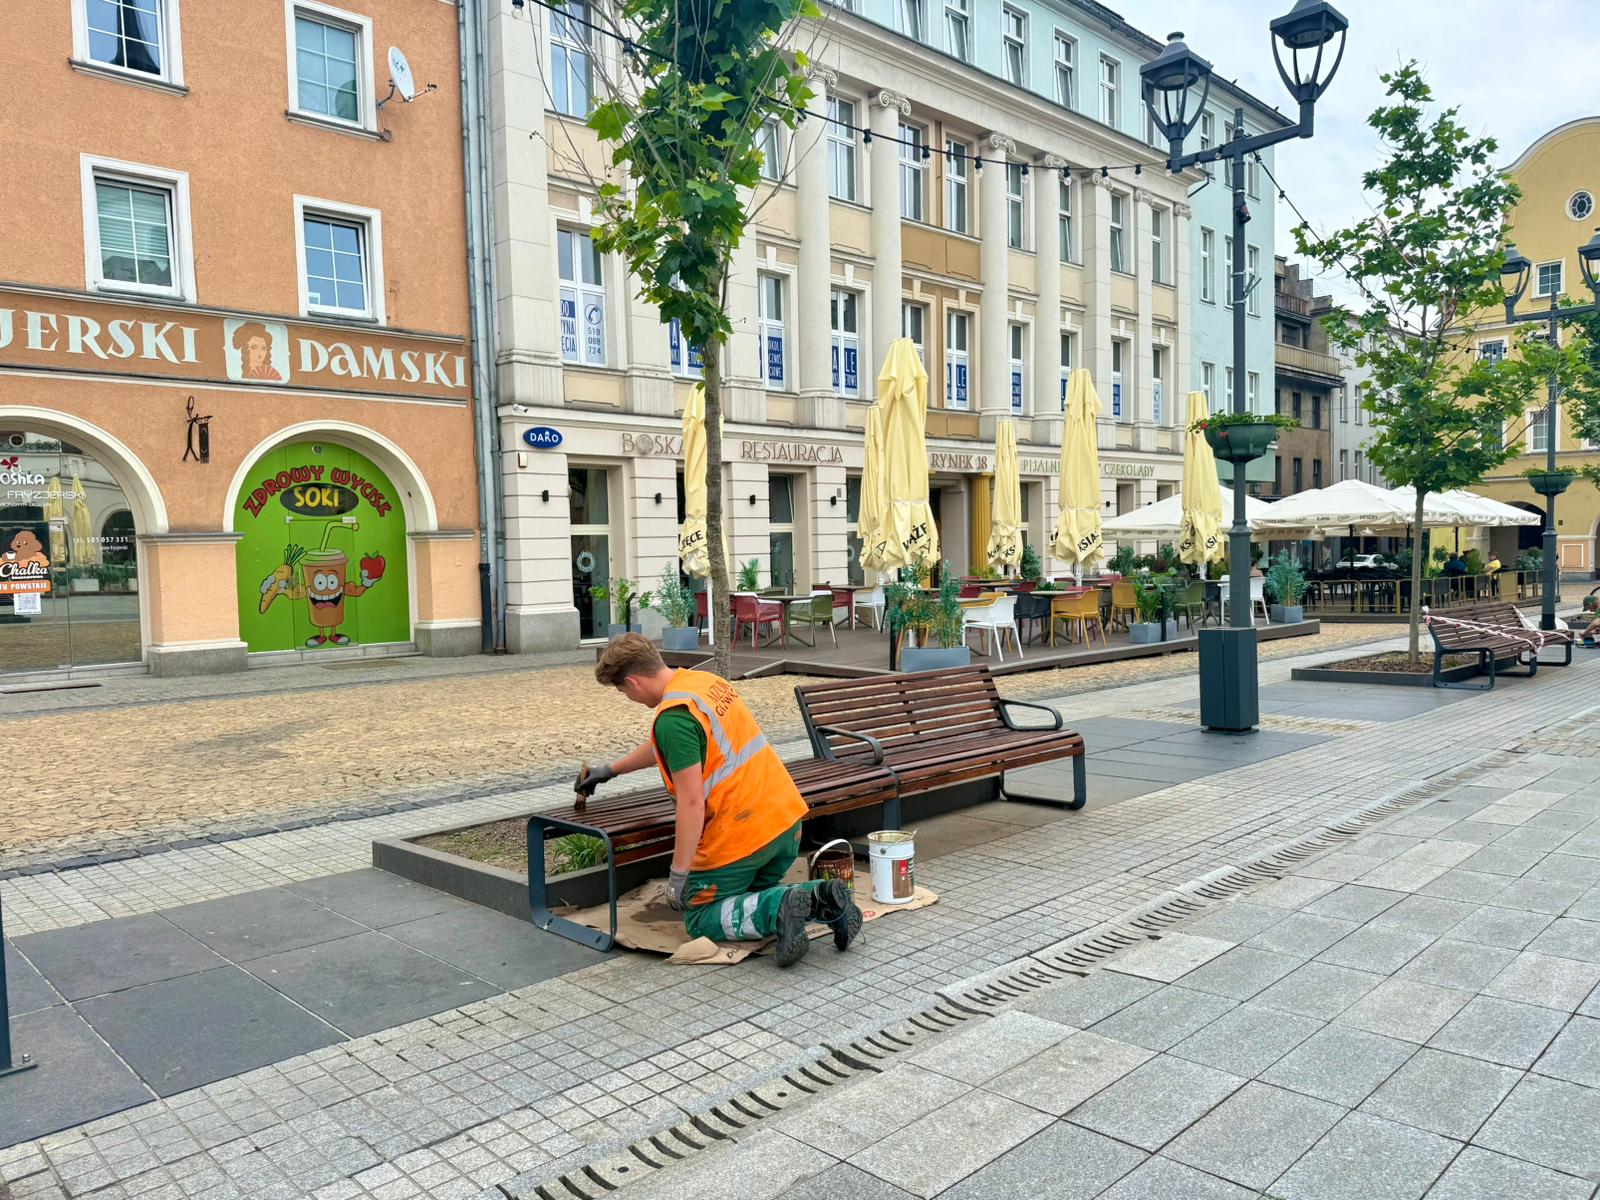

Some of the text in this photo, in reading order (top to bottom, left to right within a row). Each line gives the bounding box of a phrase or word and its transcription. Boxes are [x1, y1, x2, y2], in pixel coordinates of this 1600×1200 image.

[587, 327, 601, 336] 519
[588, 337, 601, 346] 088
[588, 346, 601, 355] 724
[741, 440, 843, 463] RESTAURACJA
[931, 452, 988, 470] RYNEK 18
[1023, 458, 1060, 473] PIJALNI
[1104, 463, 1154, 477] CZEKOLADY
[7, 490, 85, 500] FRYZJERSKI
[242, 465, 392, 519] ZDROWY WYCISK
[293, 486, 339, 508] SOKI
